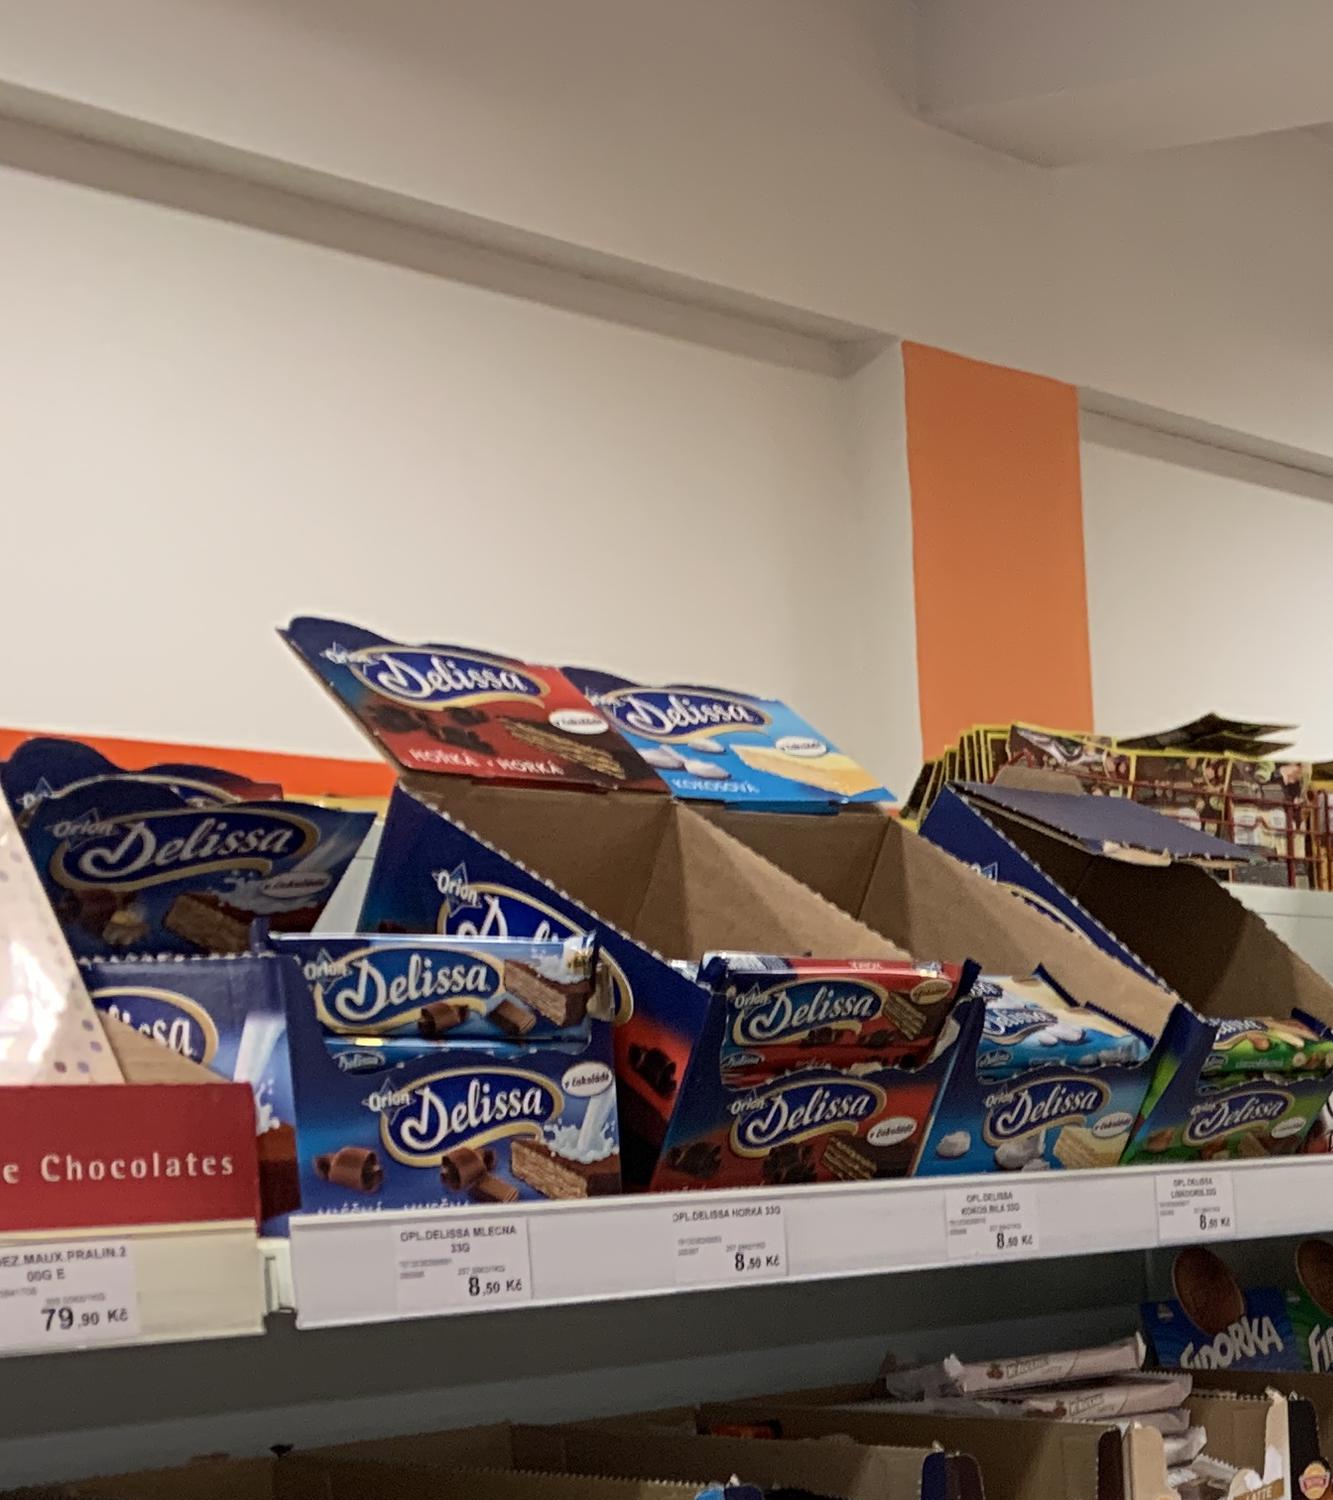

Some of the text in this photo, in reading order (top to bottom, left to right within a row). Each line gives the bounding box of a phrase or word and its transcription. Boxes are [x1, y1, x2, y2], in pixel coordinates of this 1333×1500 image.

[377, 653, 528, 702] Delissa
[627, 696, 751, 731] Delissa
[80, 813, 295, 878] Delissa
[330, 956, 491, 1017] Delissa
[754, 982, 875, 1037] Delissa
[401, 1087, 544, 1153] Delissa
[754, 1078, 871, 1138] Delissa
[999, 1076, 1099, 1133] Delissa
[1197, 1085, 1284, 1138] Delissa
[41, 1148, 236, 1185] Chocolates
[107, 1307, 129, 1324] Kč
